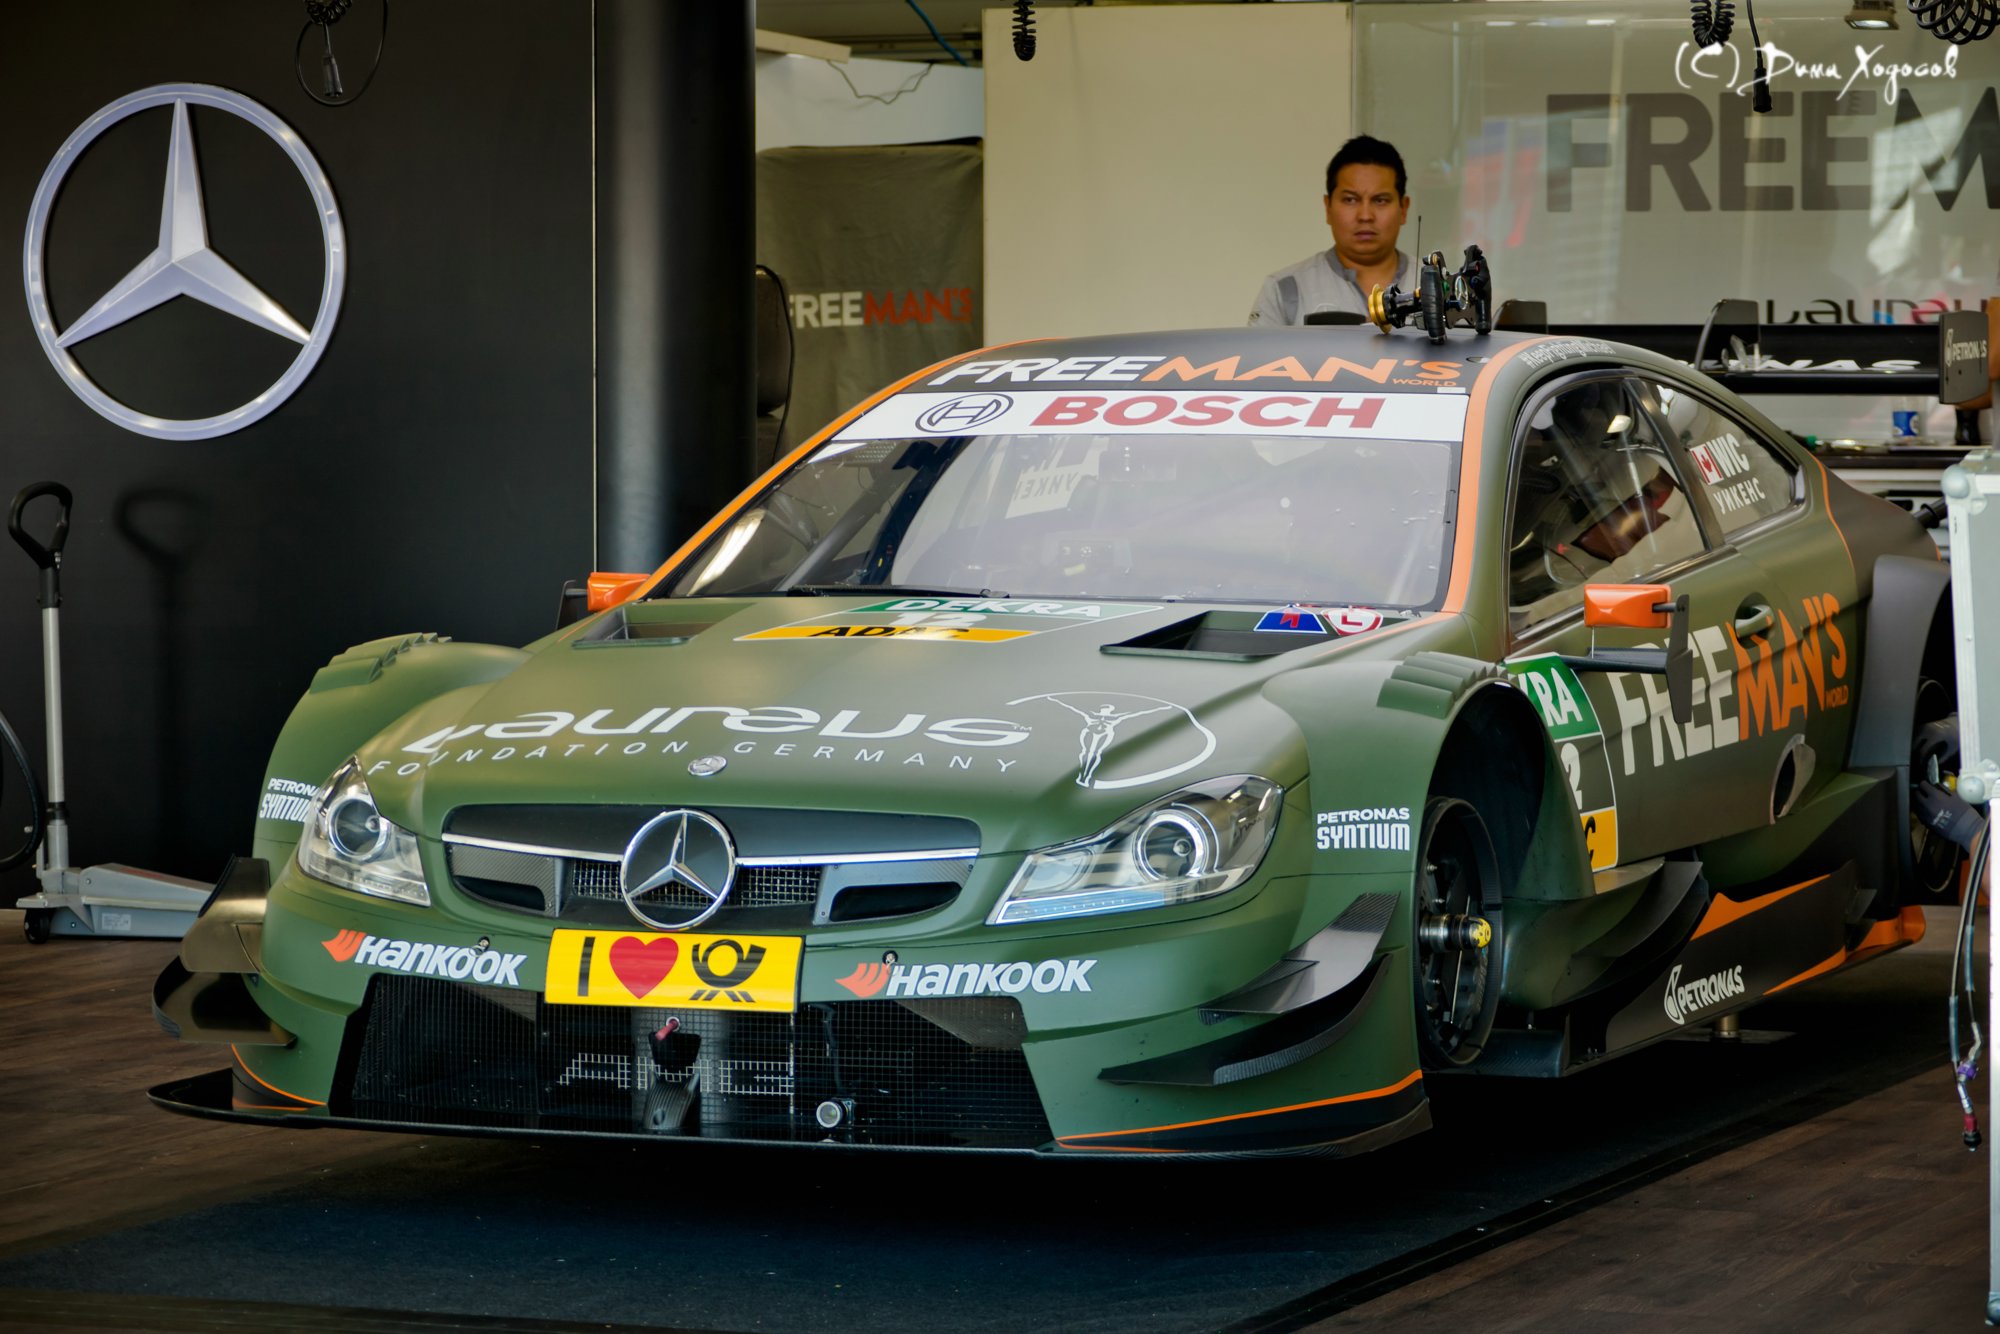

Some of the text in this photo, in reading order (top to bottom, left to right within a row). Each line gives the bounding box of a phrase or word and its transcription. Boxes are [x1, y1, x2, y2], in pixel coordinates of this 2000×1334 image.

[927, 355, 1461, 387] FREEMAN'S
[1392, 378, 1457, 387] WORLD
[1029, 395, 1387, 430] BOSCH
[886, 599, 1101, 617] DEKRA
[367, 741, 1017, 776] FOUNDATION GERMANY
[1317, 807, 1410, 825] PETRONAS
[1316, 823, 1410, 851] SYNTIUM
[577, 936, 596, 997] I
[1678, 965, 1745, 1015] PETRONAS
